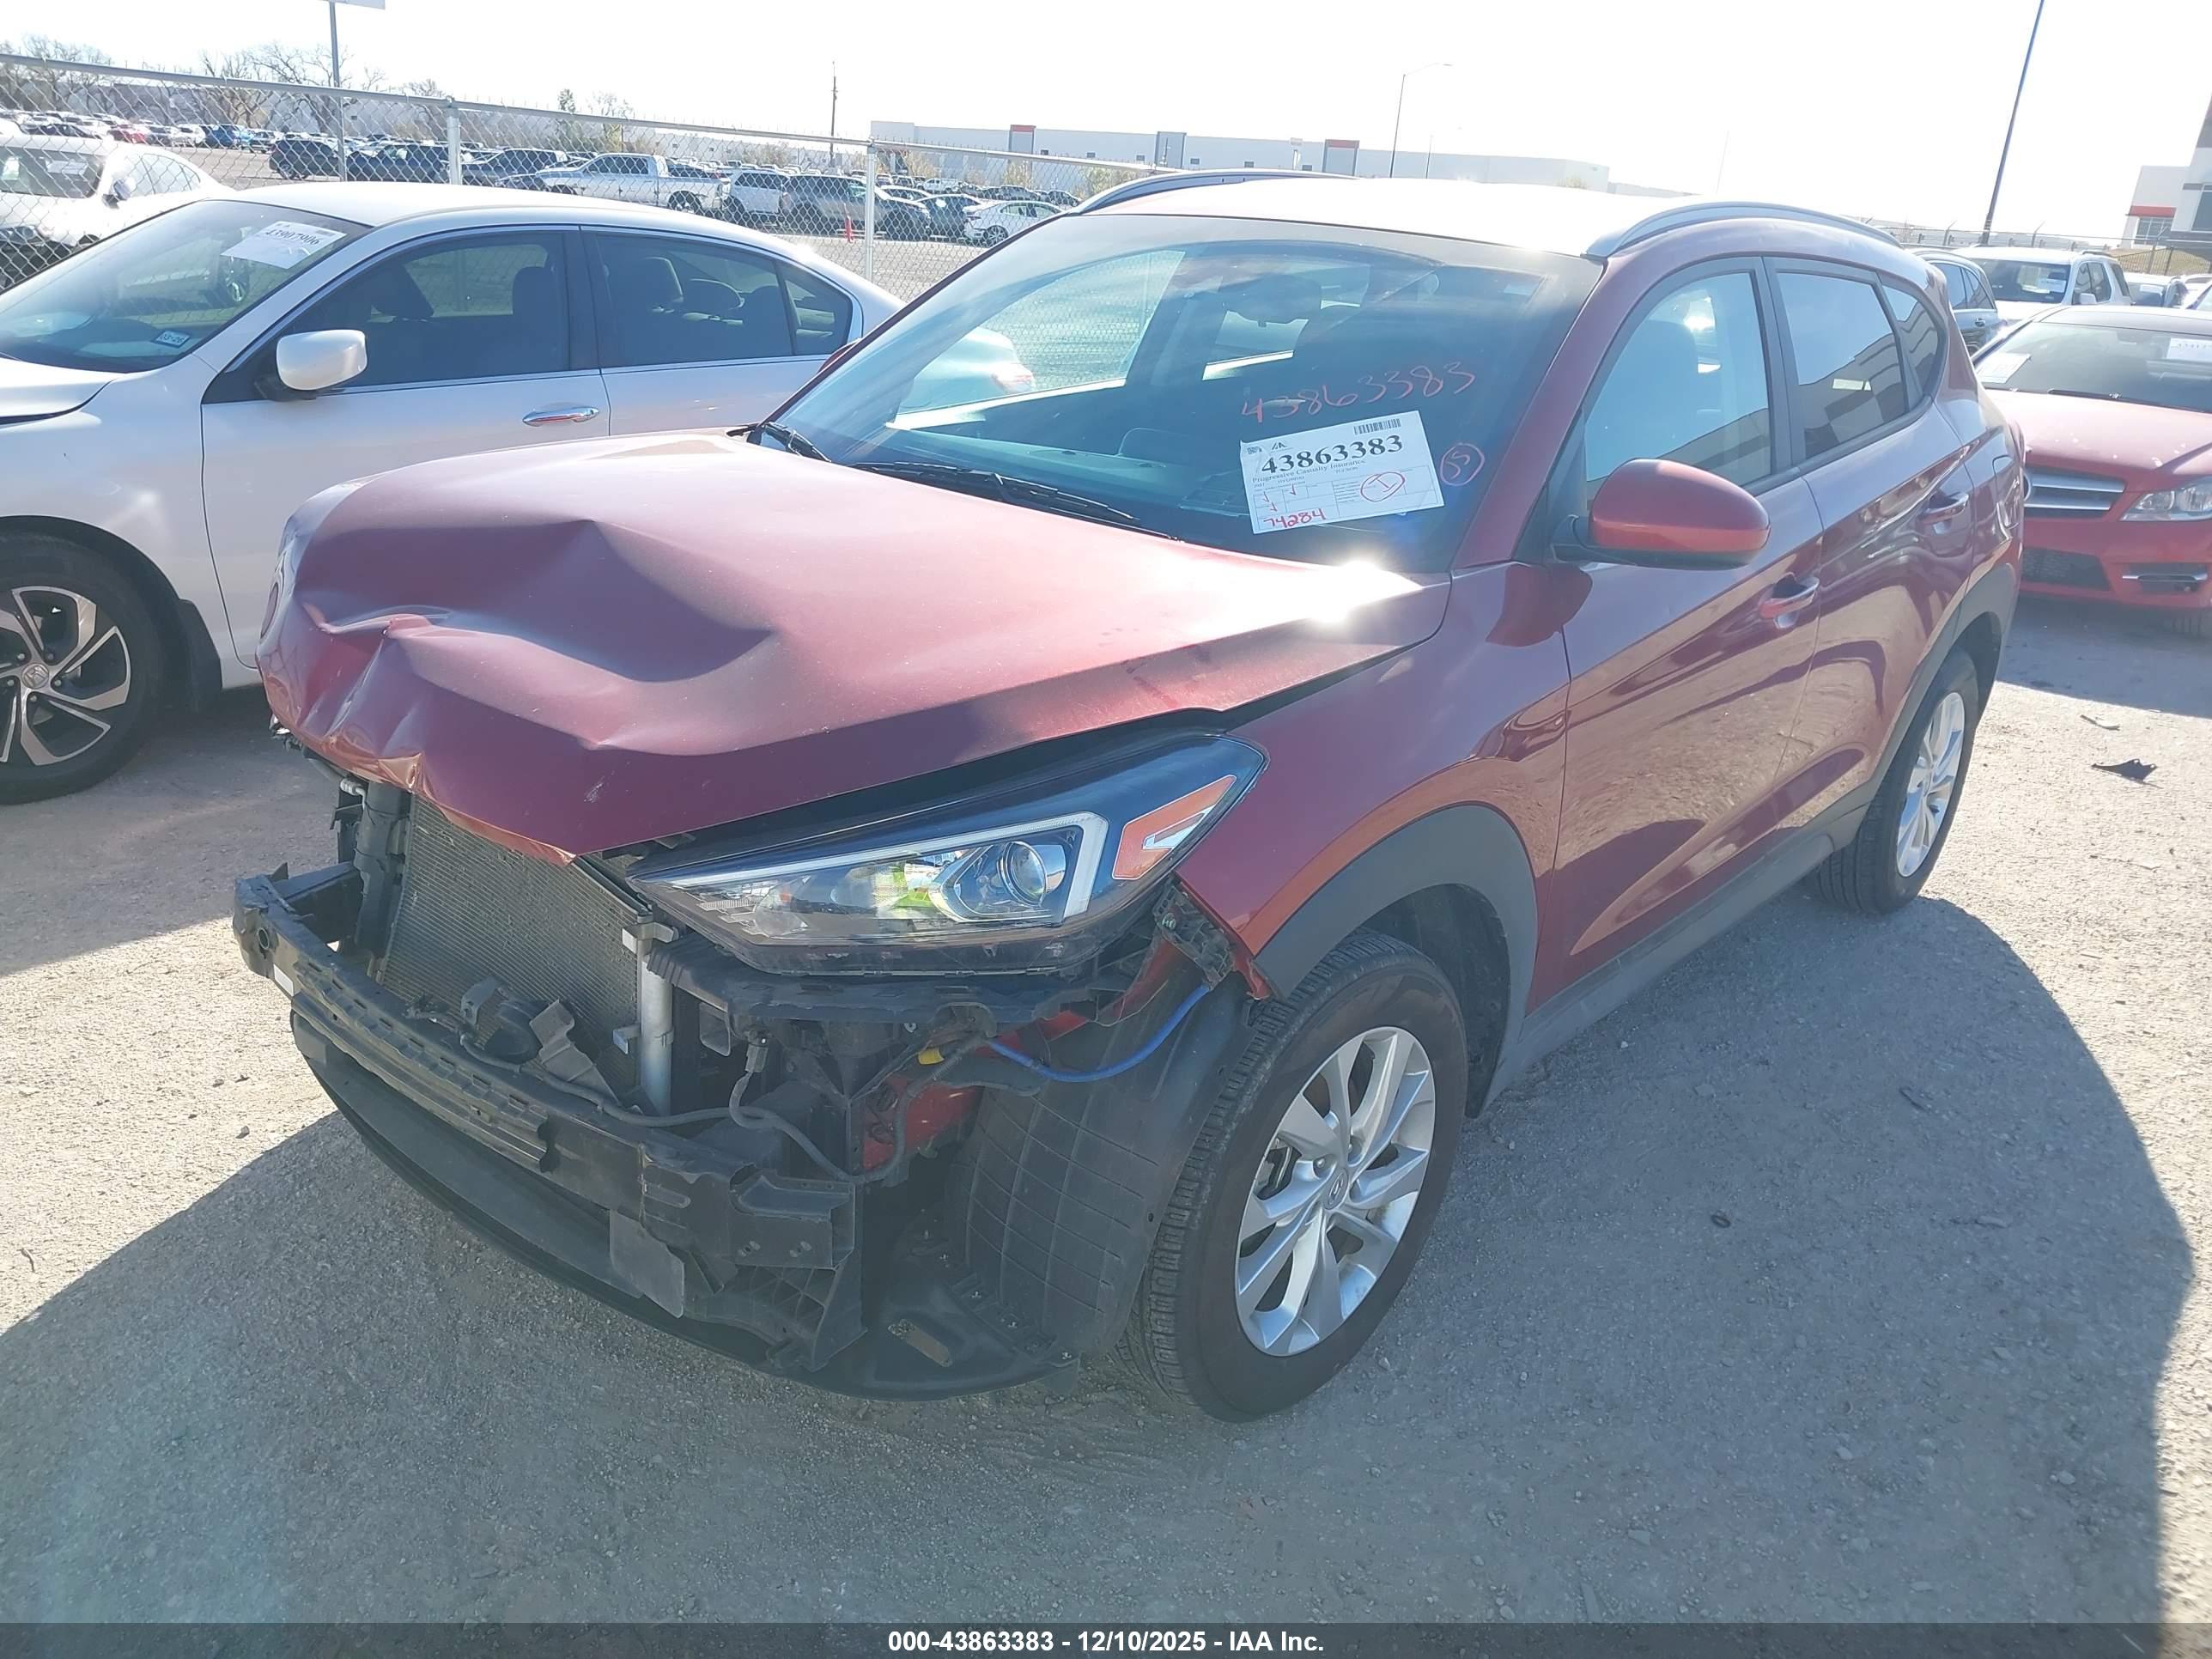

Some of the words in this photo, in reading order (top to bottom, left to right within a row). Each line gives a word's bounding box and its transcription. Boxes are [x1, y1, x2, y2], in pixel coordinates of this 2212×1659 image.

[1242, 362, 1475, 423] 43863383
[1261, 435, 1403, 473] 43863383
[1253, 472, 1295, 483] Progressive
[1297, 465, 1327, 475] Casualty
[1264, 509, 1326, 528] 74284
